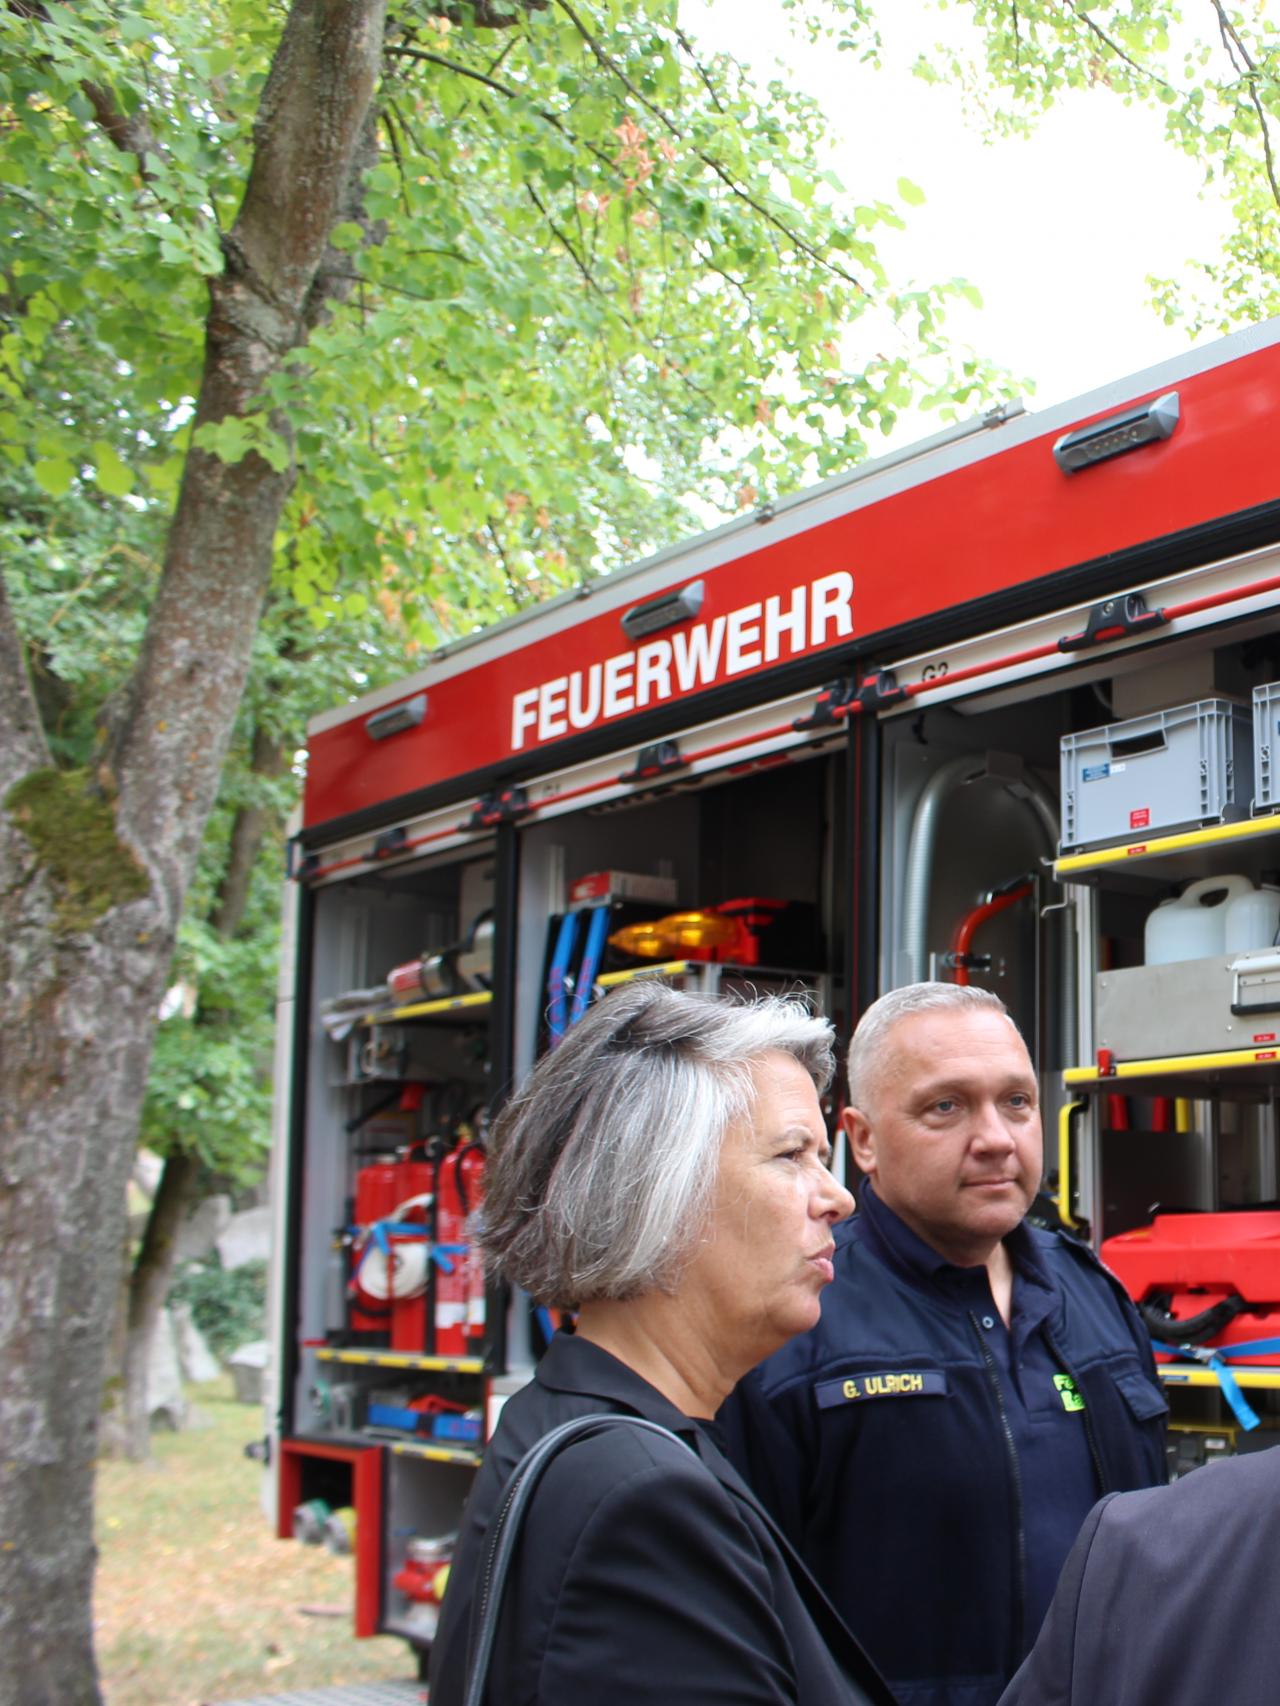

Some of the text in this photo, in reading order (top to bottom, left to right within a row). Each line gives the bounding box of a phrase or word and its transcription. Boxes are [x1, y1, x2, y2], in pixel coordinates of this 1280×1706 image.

[511, 570, 854, 751] FEUERWEHR
[842, 1373, 923, 1399] G. ULRICH
